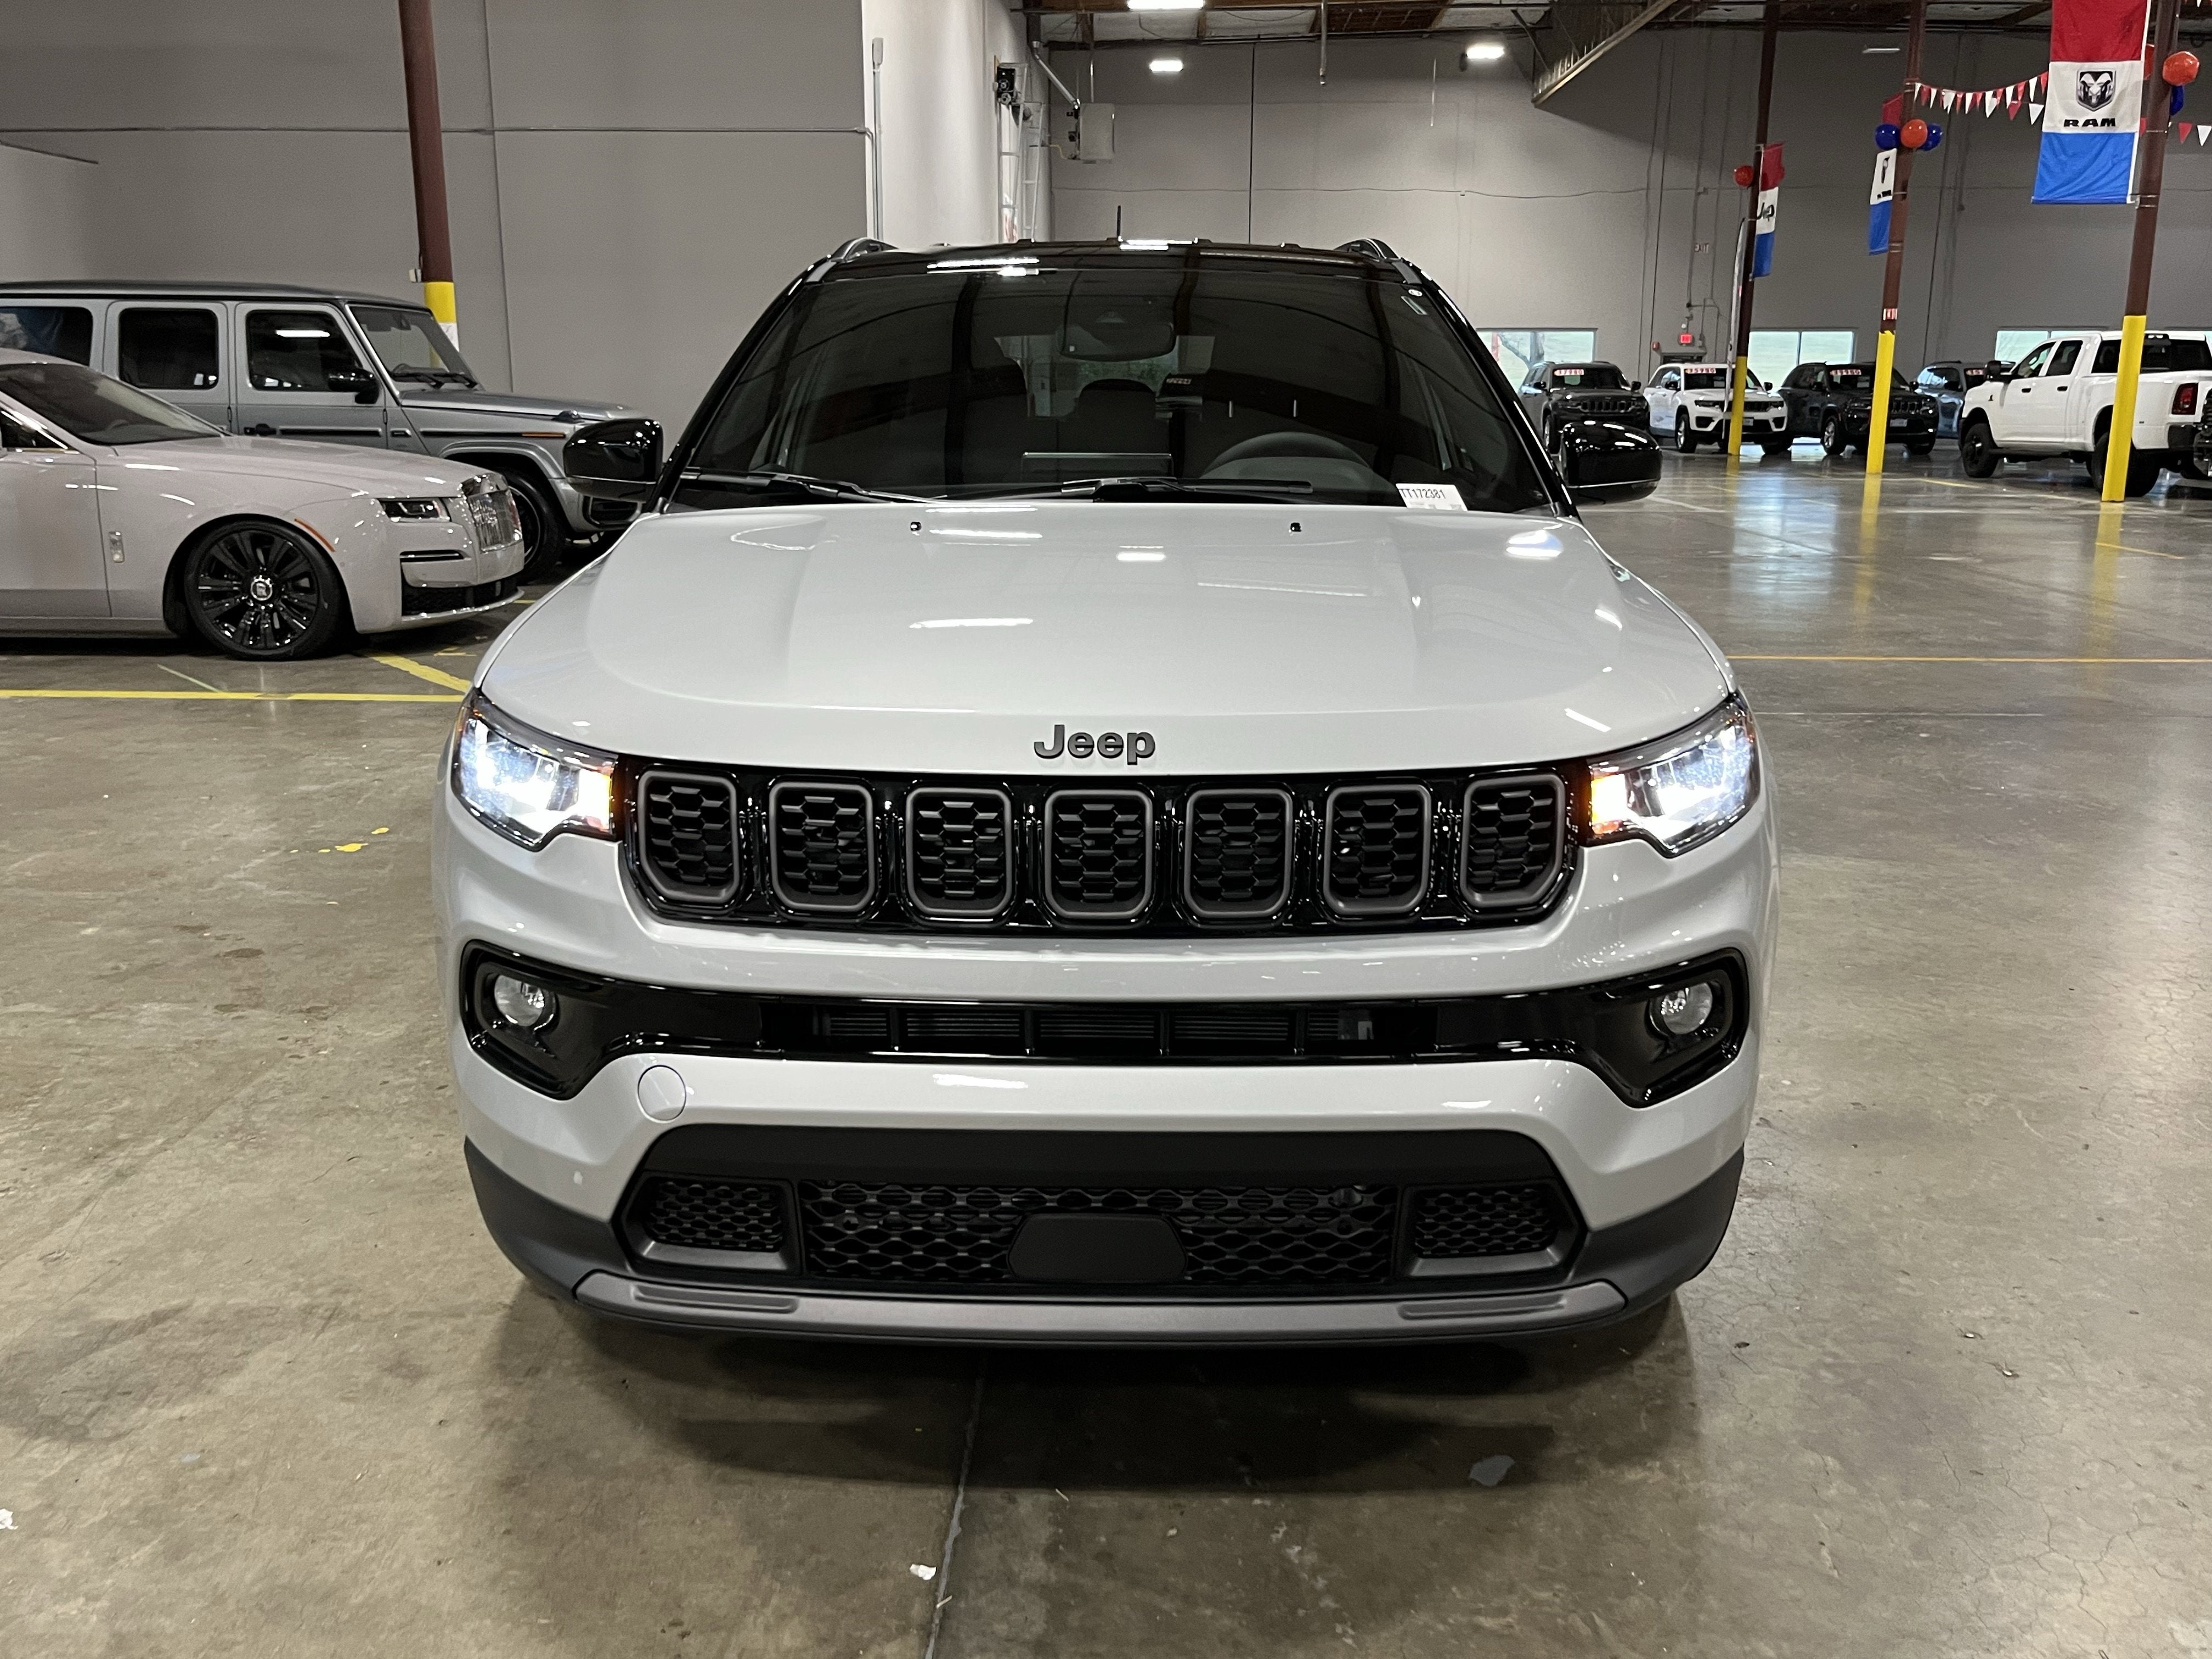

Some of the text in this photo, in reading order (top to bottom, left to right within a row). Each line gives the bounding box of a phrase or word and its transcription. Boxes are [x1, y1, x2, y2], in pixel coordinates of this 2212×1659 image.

[2064, 118, 2115, 127] RAM
[1399, 488, 1446, 499] TT172381
[1034, 724, 1155, 765] Jeep
